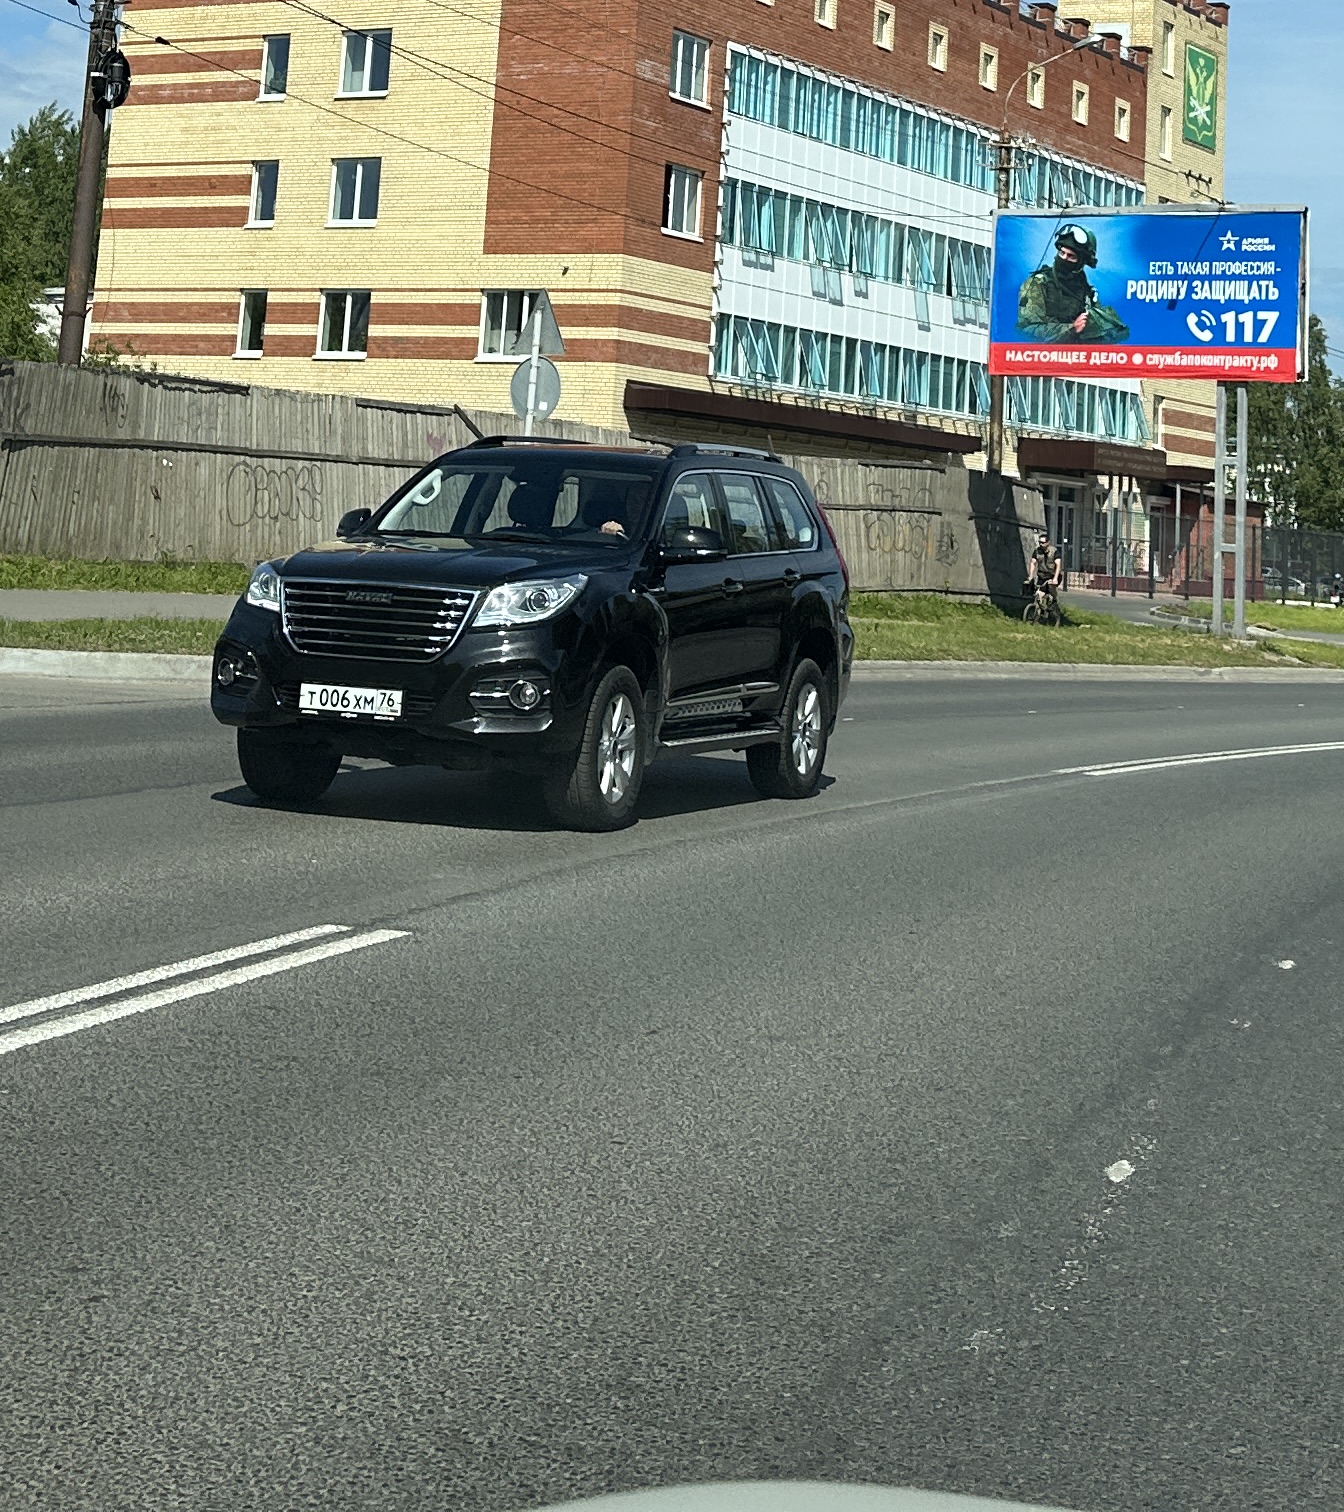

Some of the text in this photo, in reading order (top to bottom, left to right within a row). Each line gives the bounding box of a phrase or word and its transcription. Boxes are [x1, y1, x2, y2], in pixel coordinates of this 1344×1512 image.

[1149, 261, 1174, 275] ЕСТЬ
[1176, 261, 1209, 275] ТАКАЯ
[1126, 280, 1279, 304] РОДИНУ ЗАЩИЩАТЬ
[1220, 310, 1280, 342] 117
[1005, 350, 1278, 370] НАСТОЯЩЕЕ ДЕЛО службапоконтракту.рф
